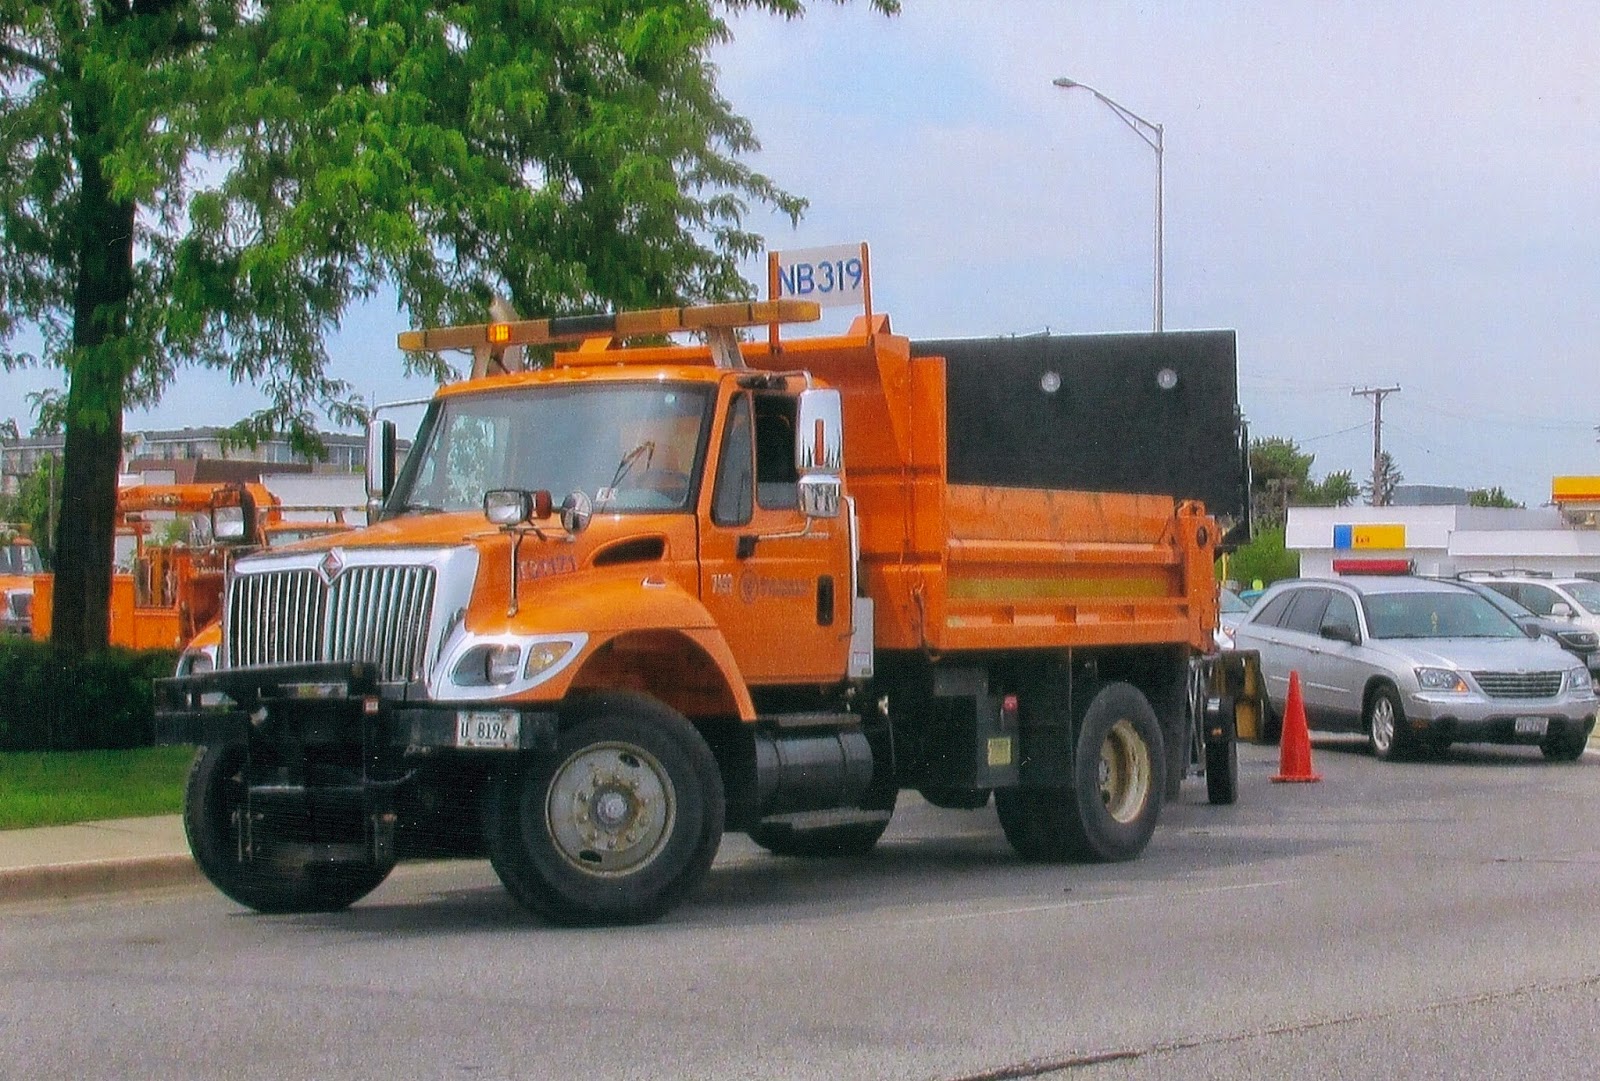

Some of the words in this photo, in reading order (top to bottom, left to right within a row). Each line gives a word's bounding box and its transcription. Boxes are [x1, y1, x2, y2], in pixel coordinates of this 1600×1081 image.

[779, 258, 862, 296] NB319
[461, 721, 469, 738] U
[477, 721, 507, 740] 8196
